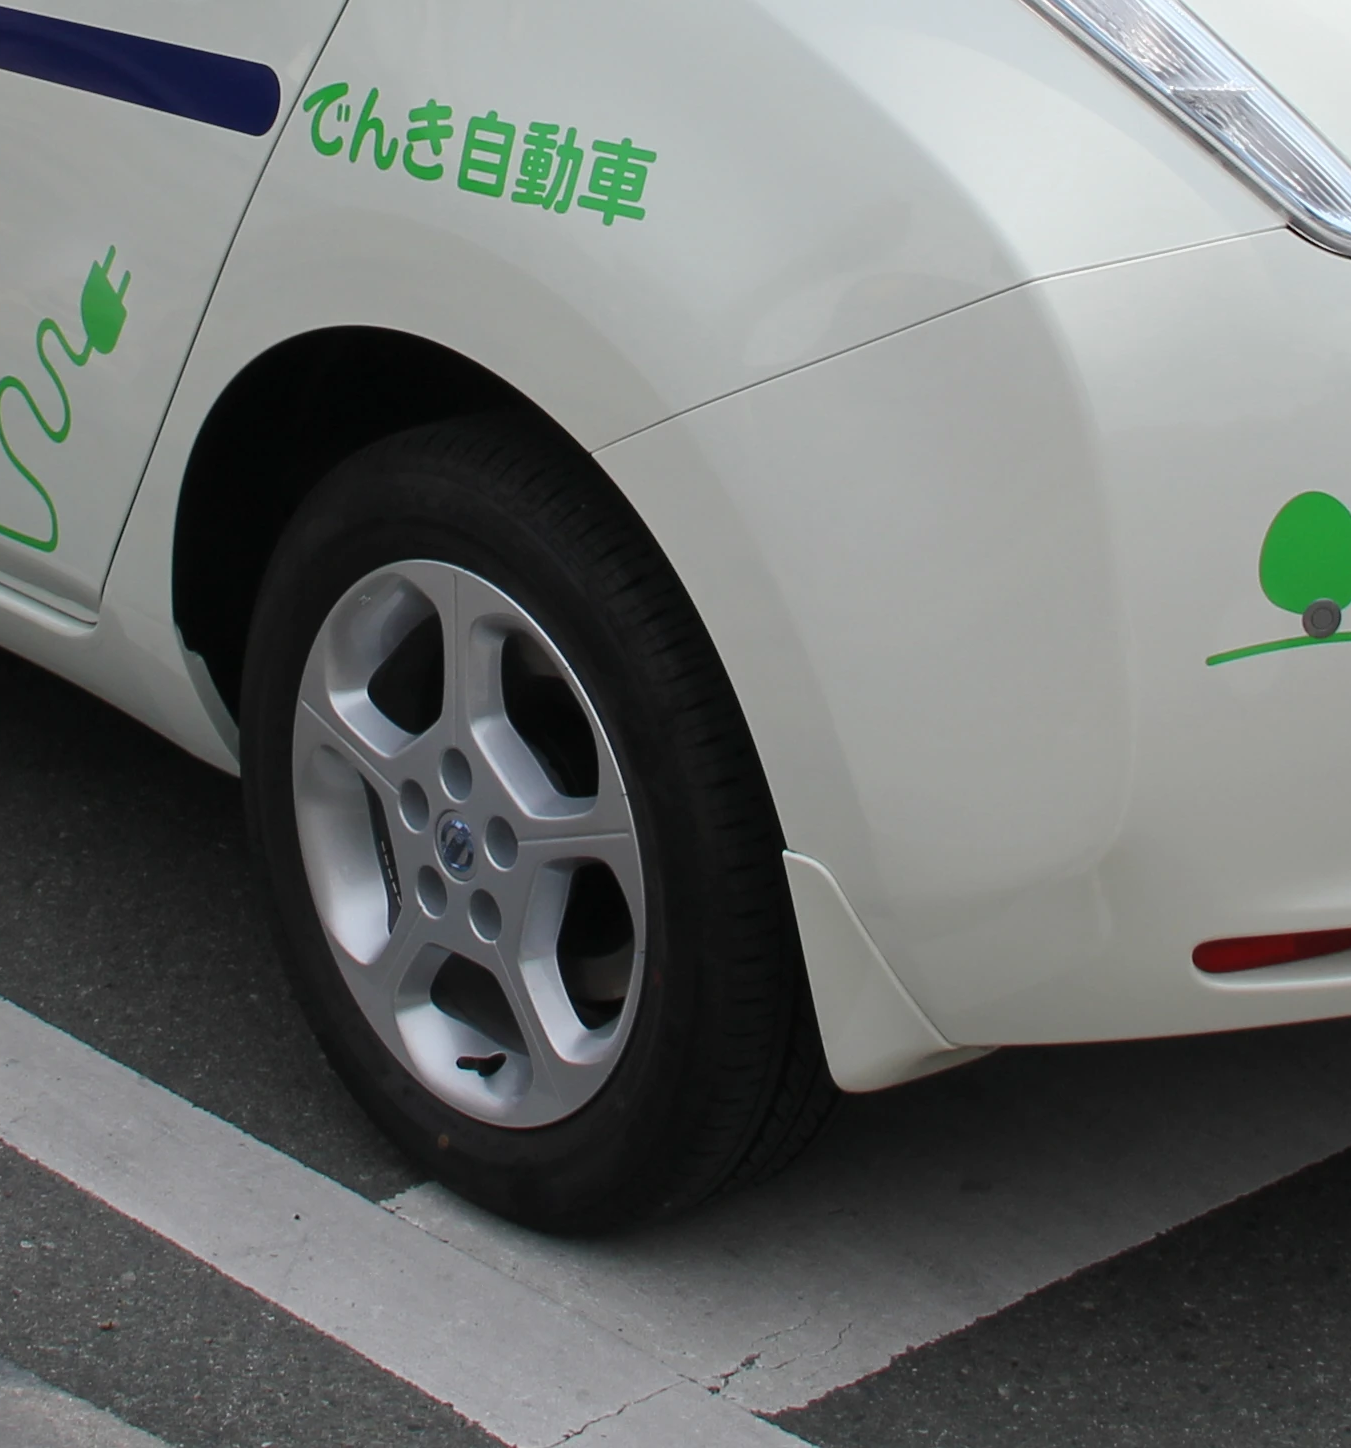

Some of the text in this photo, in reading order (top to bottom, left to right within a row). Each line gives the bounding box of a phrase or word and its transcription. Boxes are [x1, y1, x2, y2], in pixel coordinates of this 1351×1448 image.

[302, 81, 659, 227] でんき自動車
